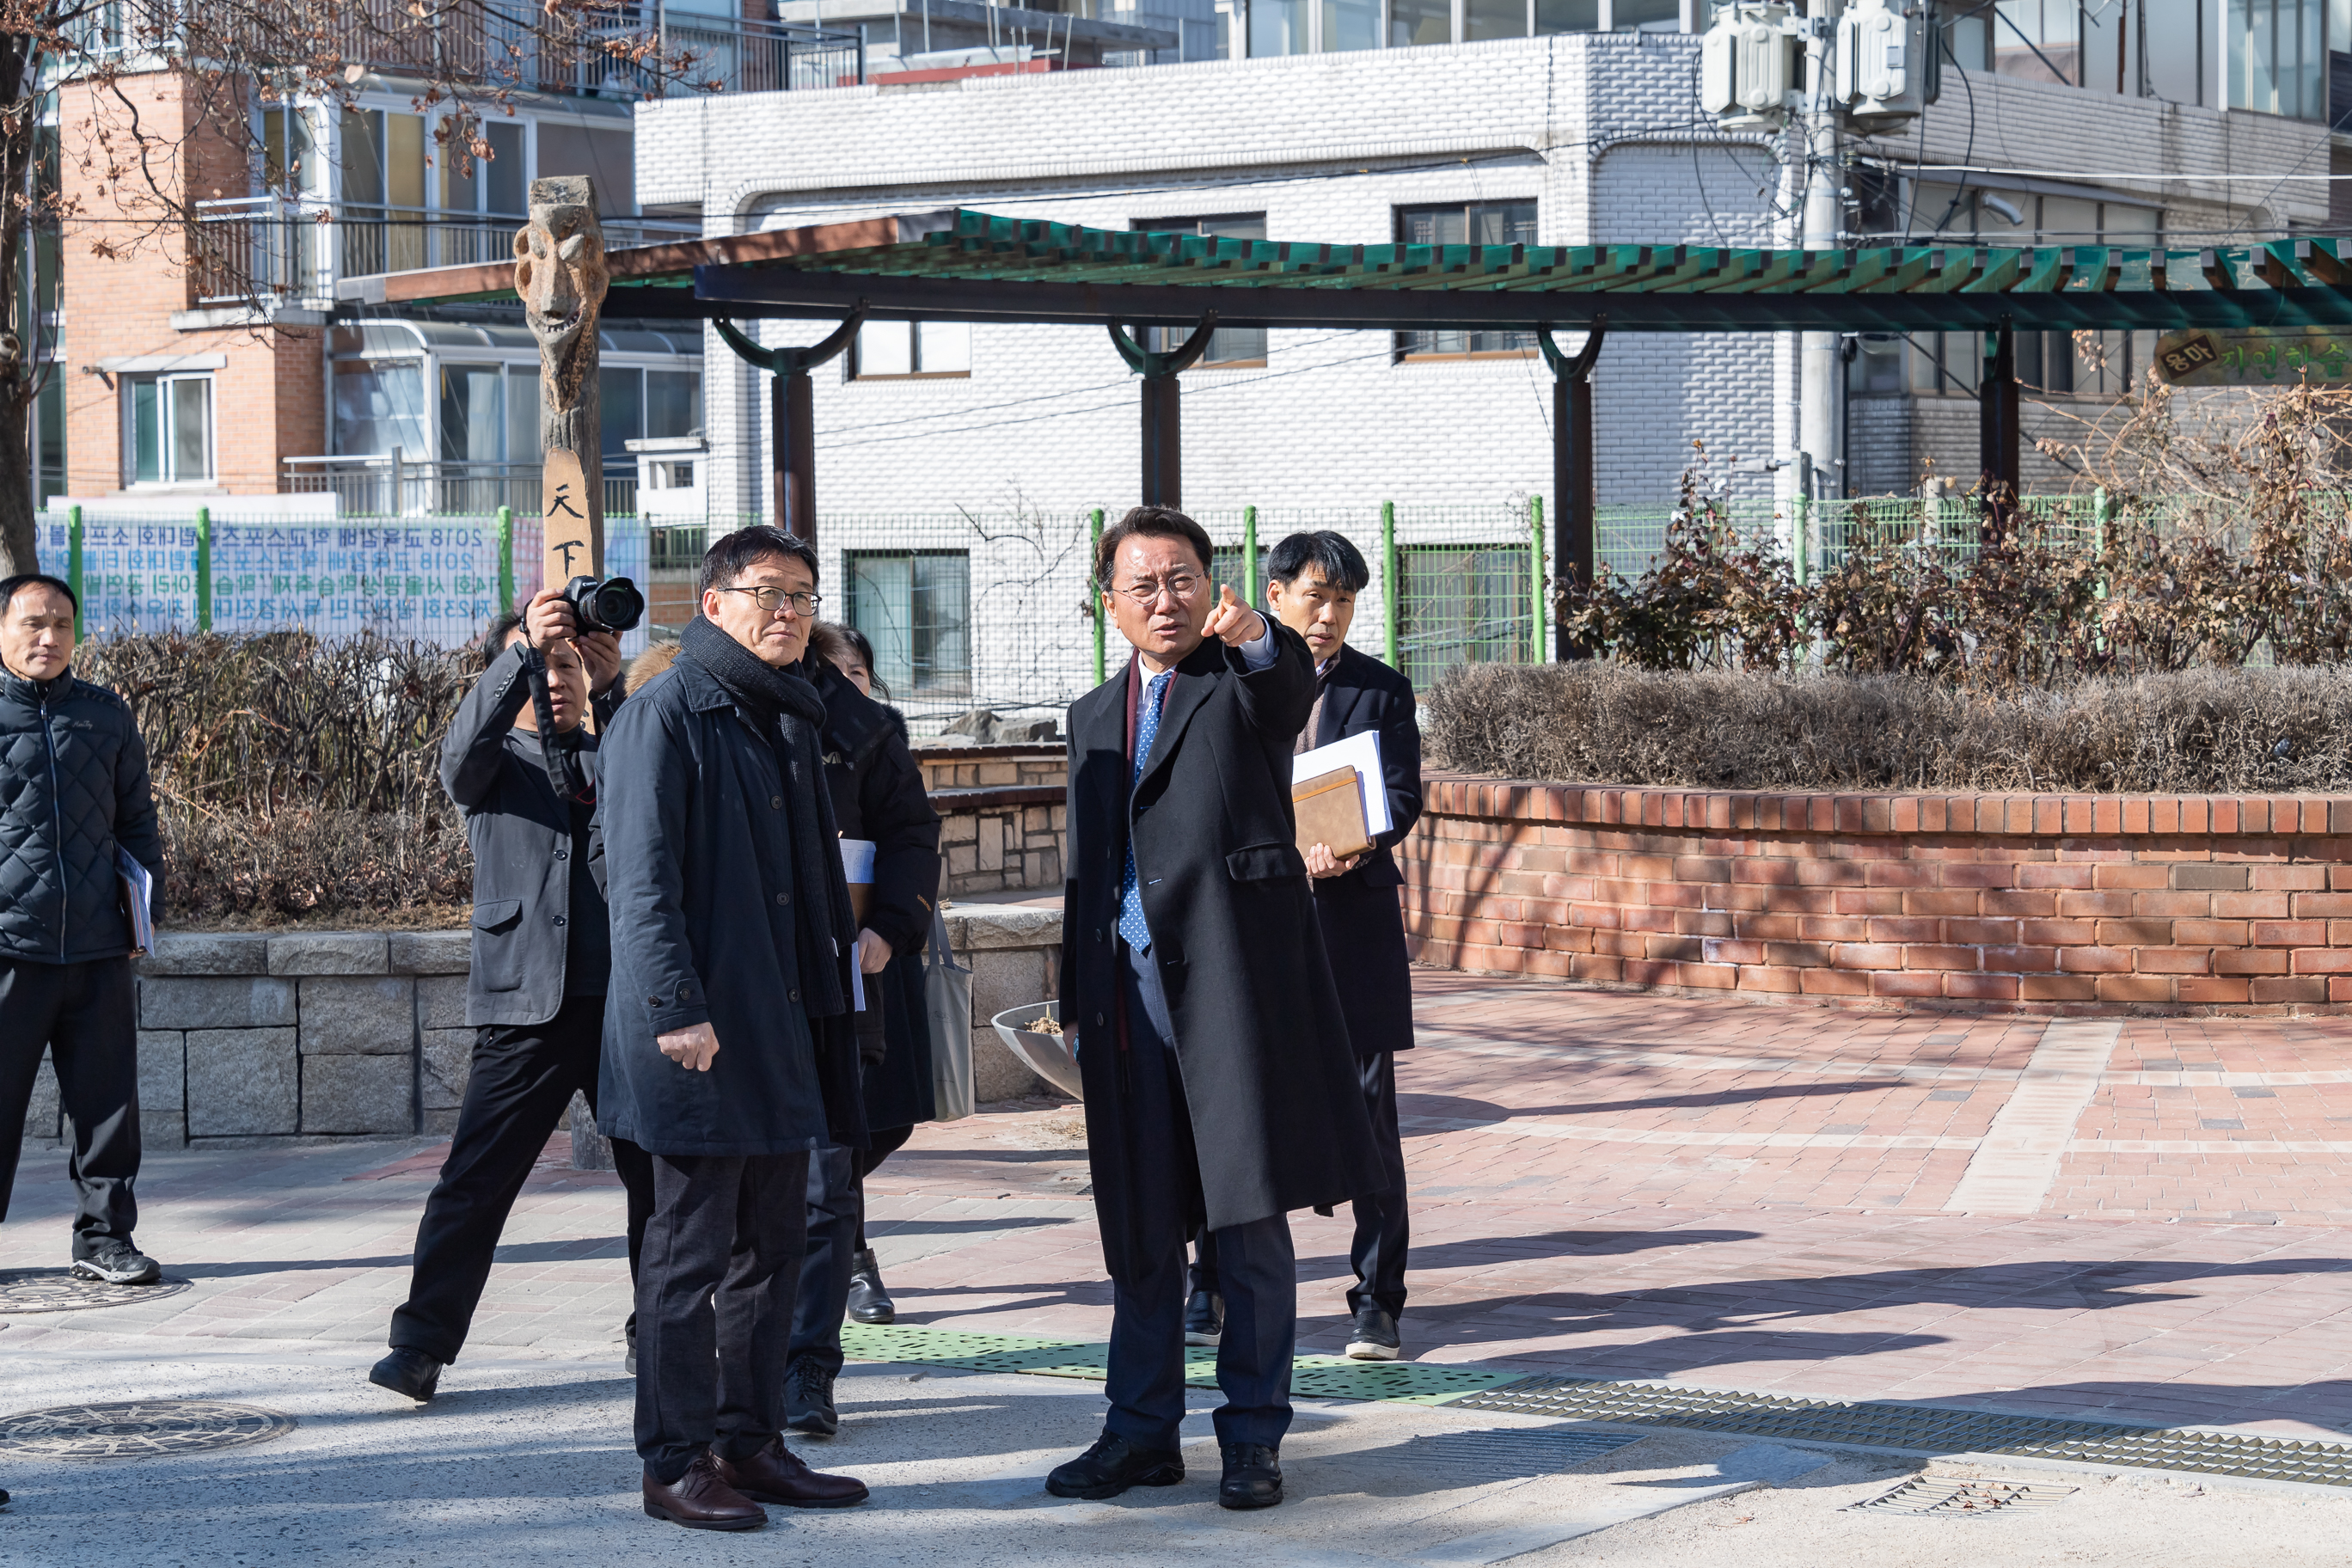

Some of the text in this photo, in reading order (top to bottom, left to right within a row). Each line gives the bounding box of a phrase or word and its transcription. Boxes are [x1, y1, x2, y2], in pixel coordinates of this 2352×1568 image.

[2165, 343, 2348, 379] 용마 자연학습
[546, 483, 585, 579] 天下
